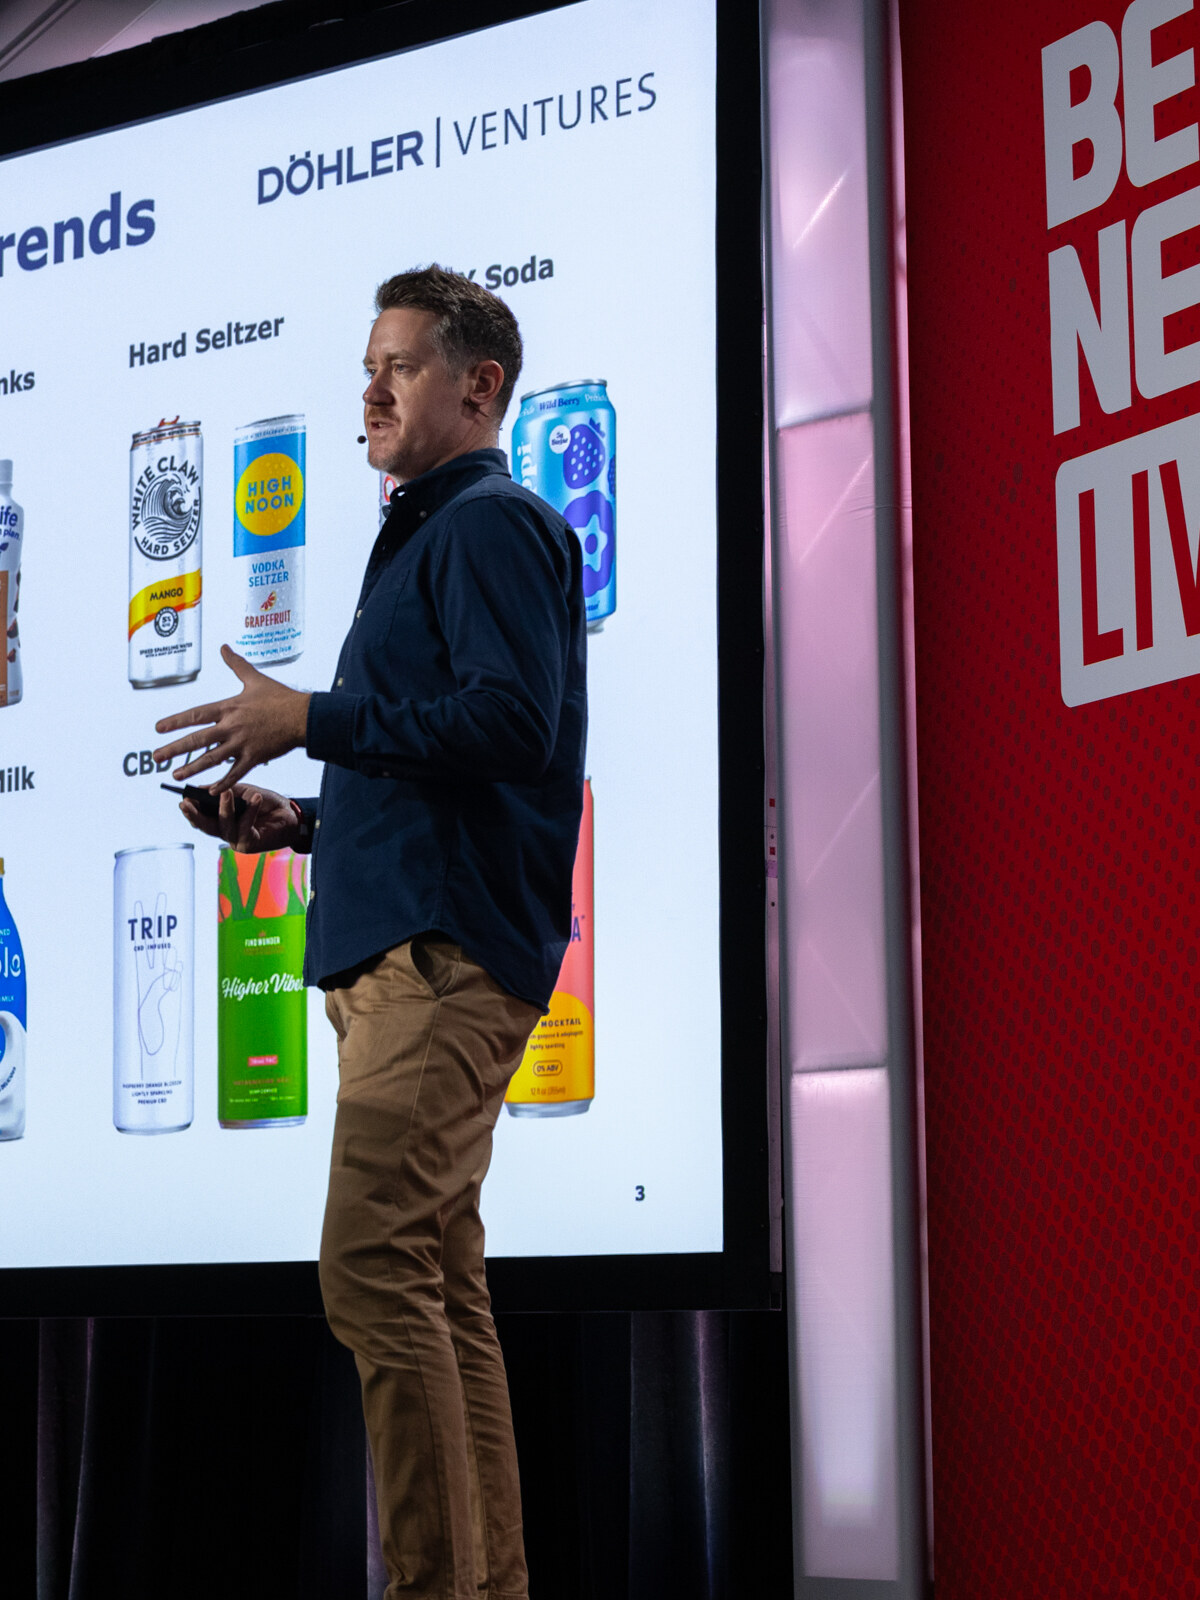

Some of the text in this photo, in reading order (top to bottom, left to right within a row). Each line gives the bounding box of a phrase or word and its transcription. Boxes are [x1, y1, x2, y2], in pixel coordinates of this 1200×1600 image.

[1041, 0, 1200, 230] BE
[257, 72, 658, 206] DÖHLER VENTURES
[485, 255, 555, 291] Soda
[1048, 195, 1200, 436] NE
[128, 314, 285, 369] Hard Seltzer
[539, 396, 580, 410] Wild Berry
[131, 454, 199, 531] WHITE CLAW
[247, 474, 293, 498] HIGH
[244, 492, 295, 515] NOON
[140, 498, 200, 556] HARD SELTZER
[251, 559, 286, 575] VODKA
[1078, 458, 1200, 667] LIV
[248, 570, 290, 588] SELTZER
[149, 587, 184, 602] MANGO
[244, 609, 292, 629] GRAPEFRUIT
[127, 914, 178, 942] TRIP
[146, 942, 172, 951] INFUSED
[1, 994, 15, 1003] MILK
[221, 976, 270, 1002] Higher
[540, 1017, 582, 1028] MOCKTAIL
[546, 1064, 559, 1072] ABV
[634, 1184, 646, 1200] 3
